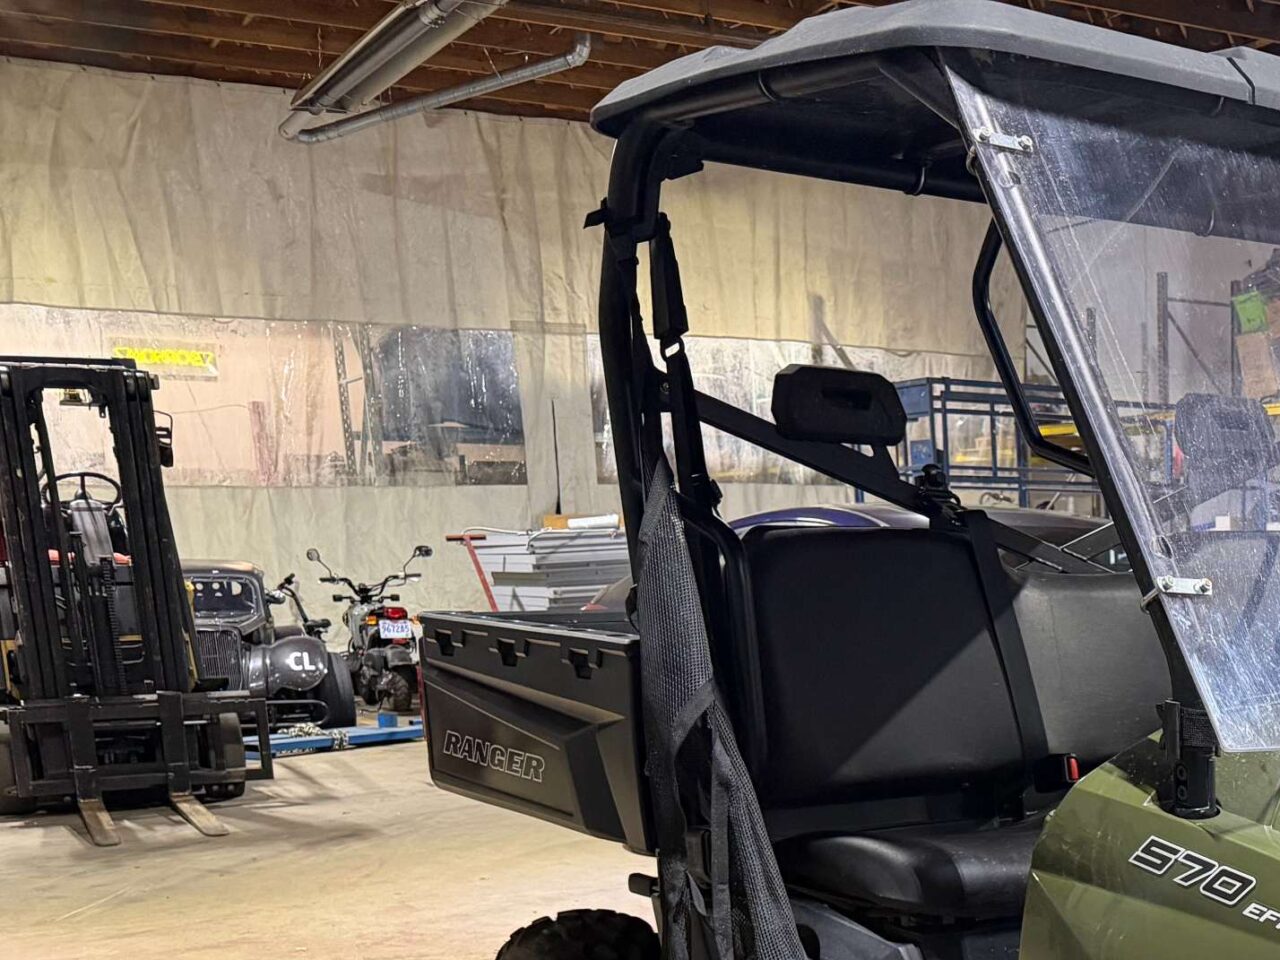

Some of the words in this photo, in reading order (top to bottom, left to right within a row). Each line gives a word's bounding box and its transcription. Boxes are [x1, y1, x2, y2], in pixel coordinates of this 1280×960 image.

[288, 651, 316, 671] CL
[443, 729, 545, 782] RANGER
[1128, 835, 1257, 906] 570
